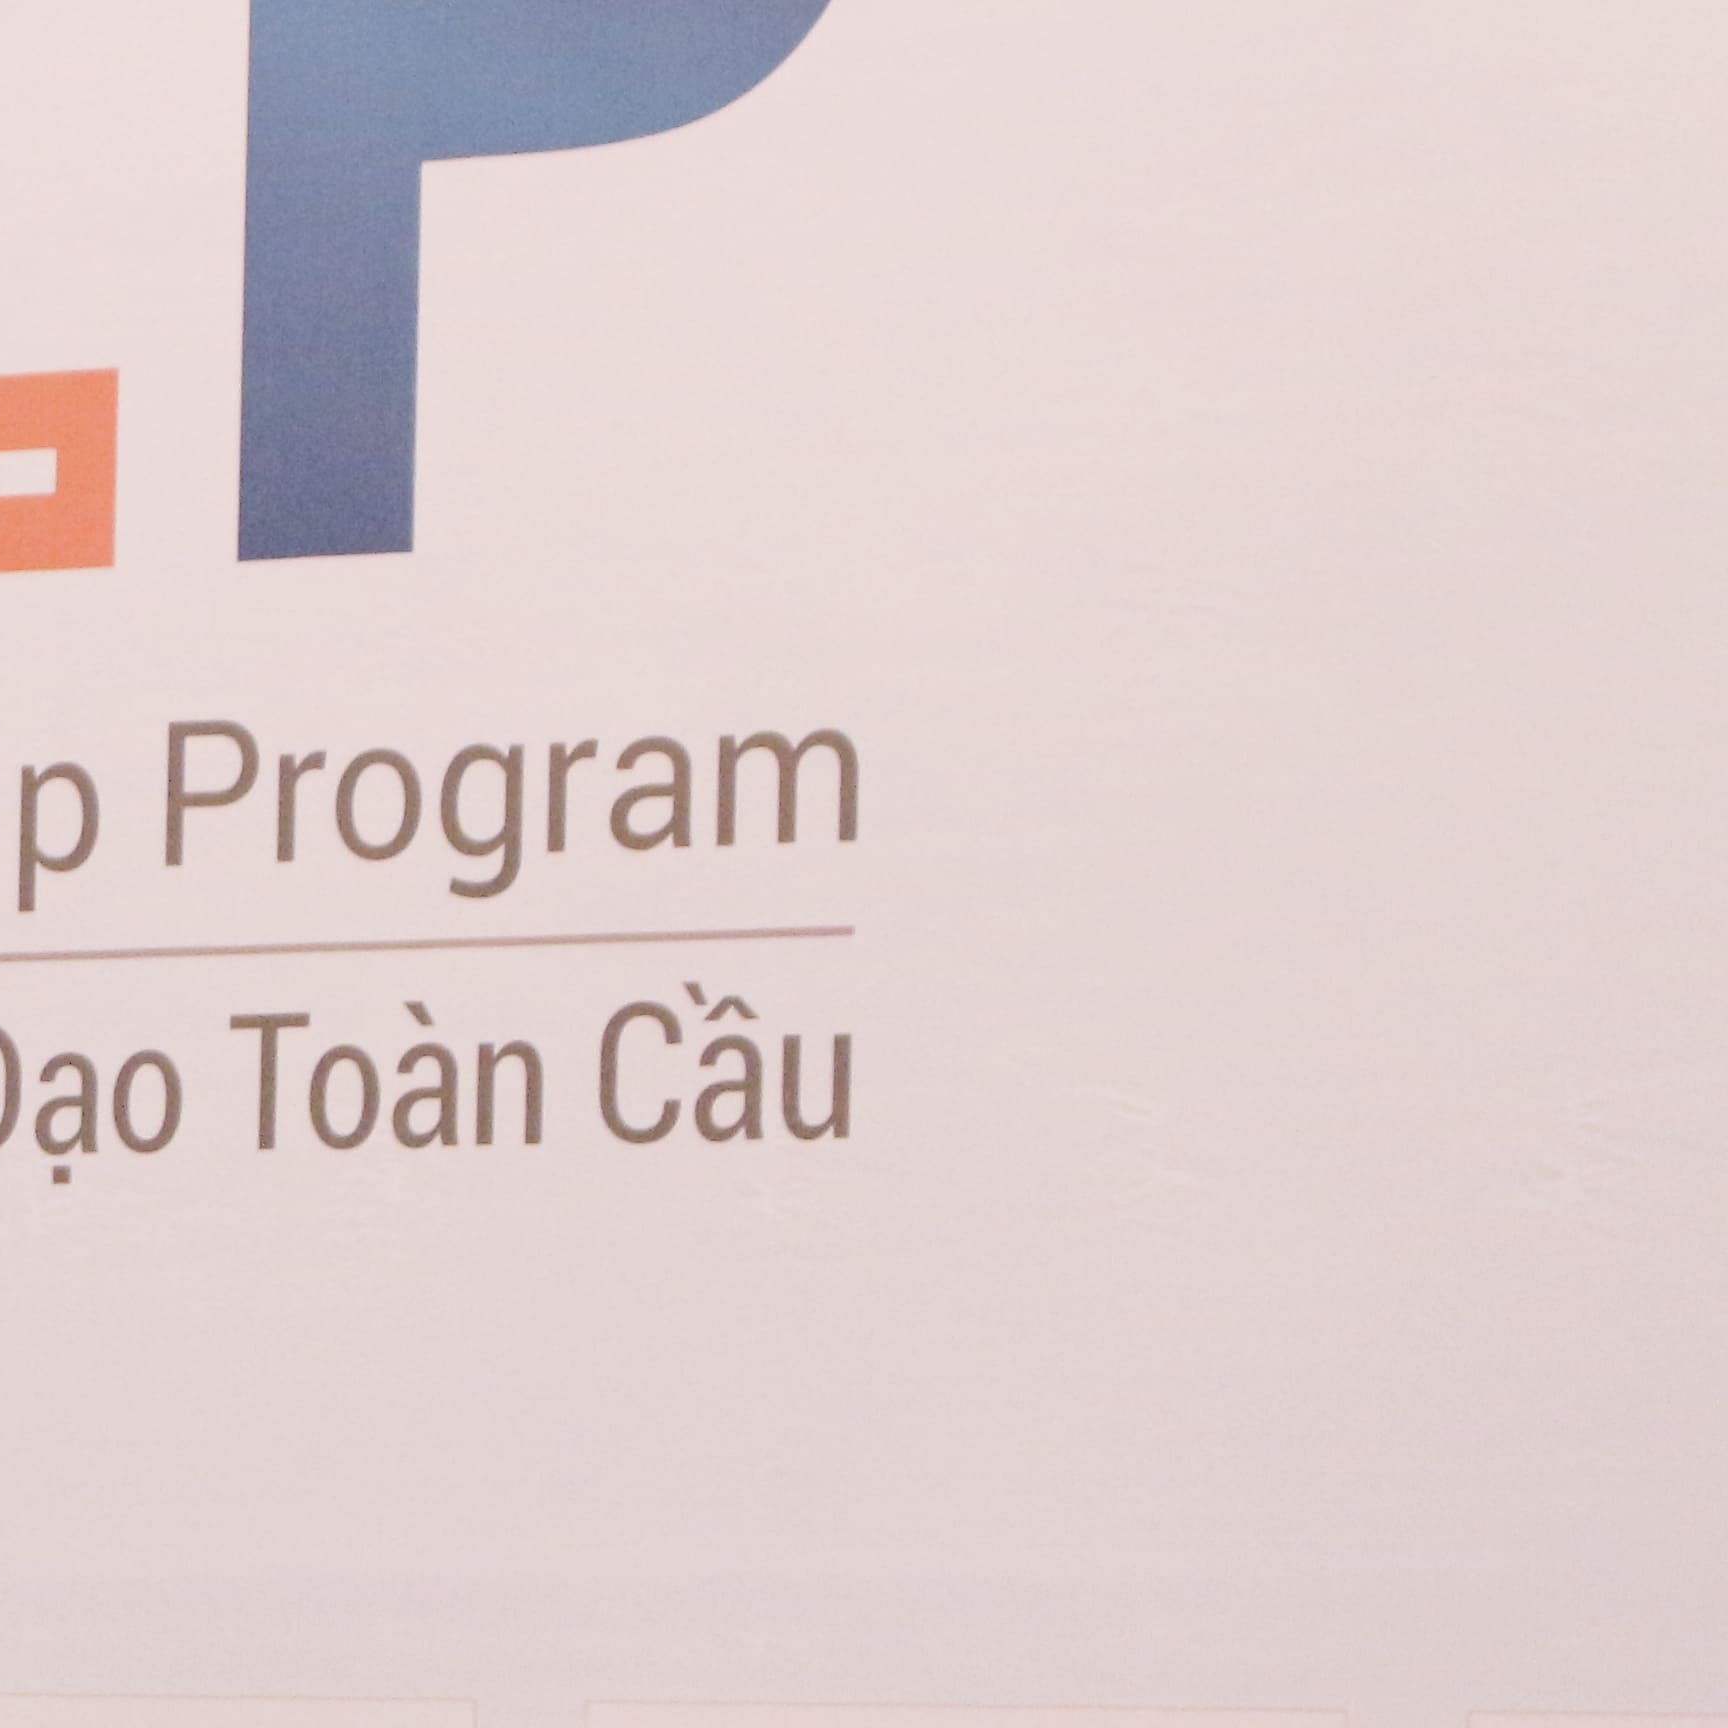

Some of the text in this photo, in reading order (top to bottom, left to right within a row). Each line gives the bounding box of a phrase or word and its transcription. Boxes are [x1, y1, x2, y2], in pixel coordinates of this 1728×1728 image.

[163, 719, 860, 900] Program
[228, 1000, 544, 1152] Toàn
[598, 980, 853, 1146] Cầu
